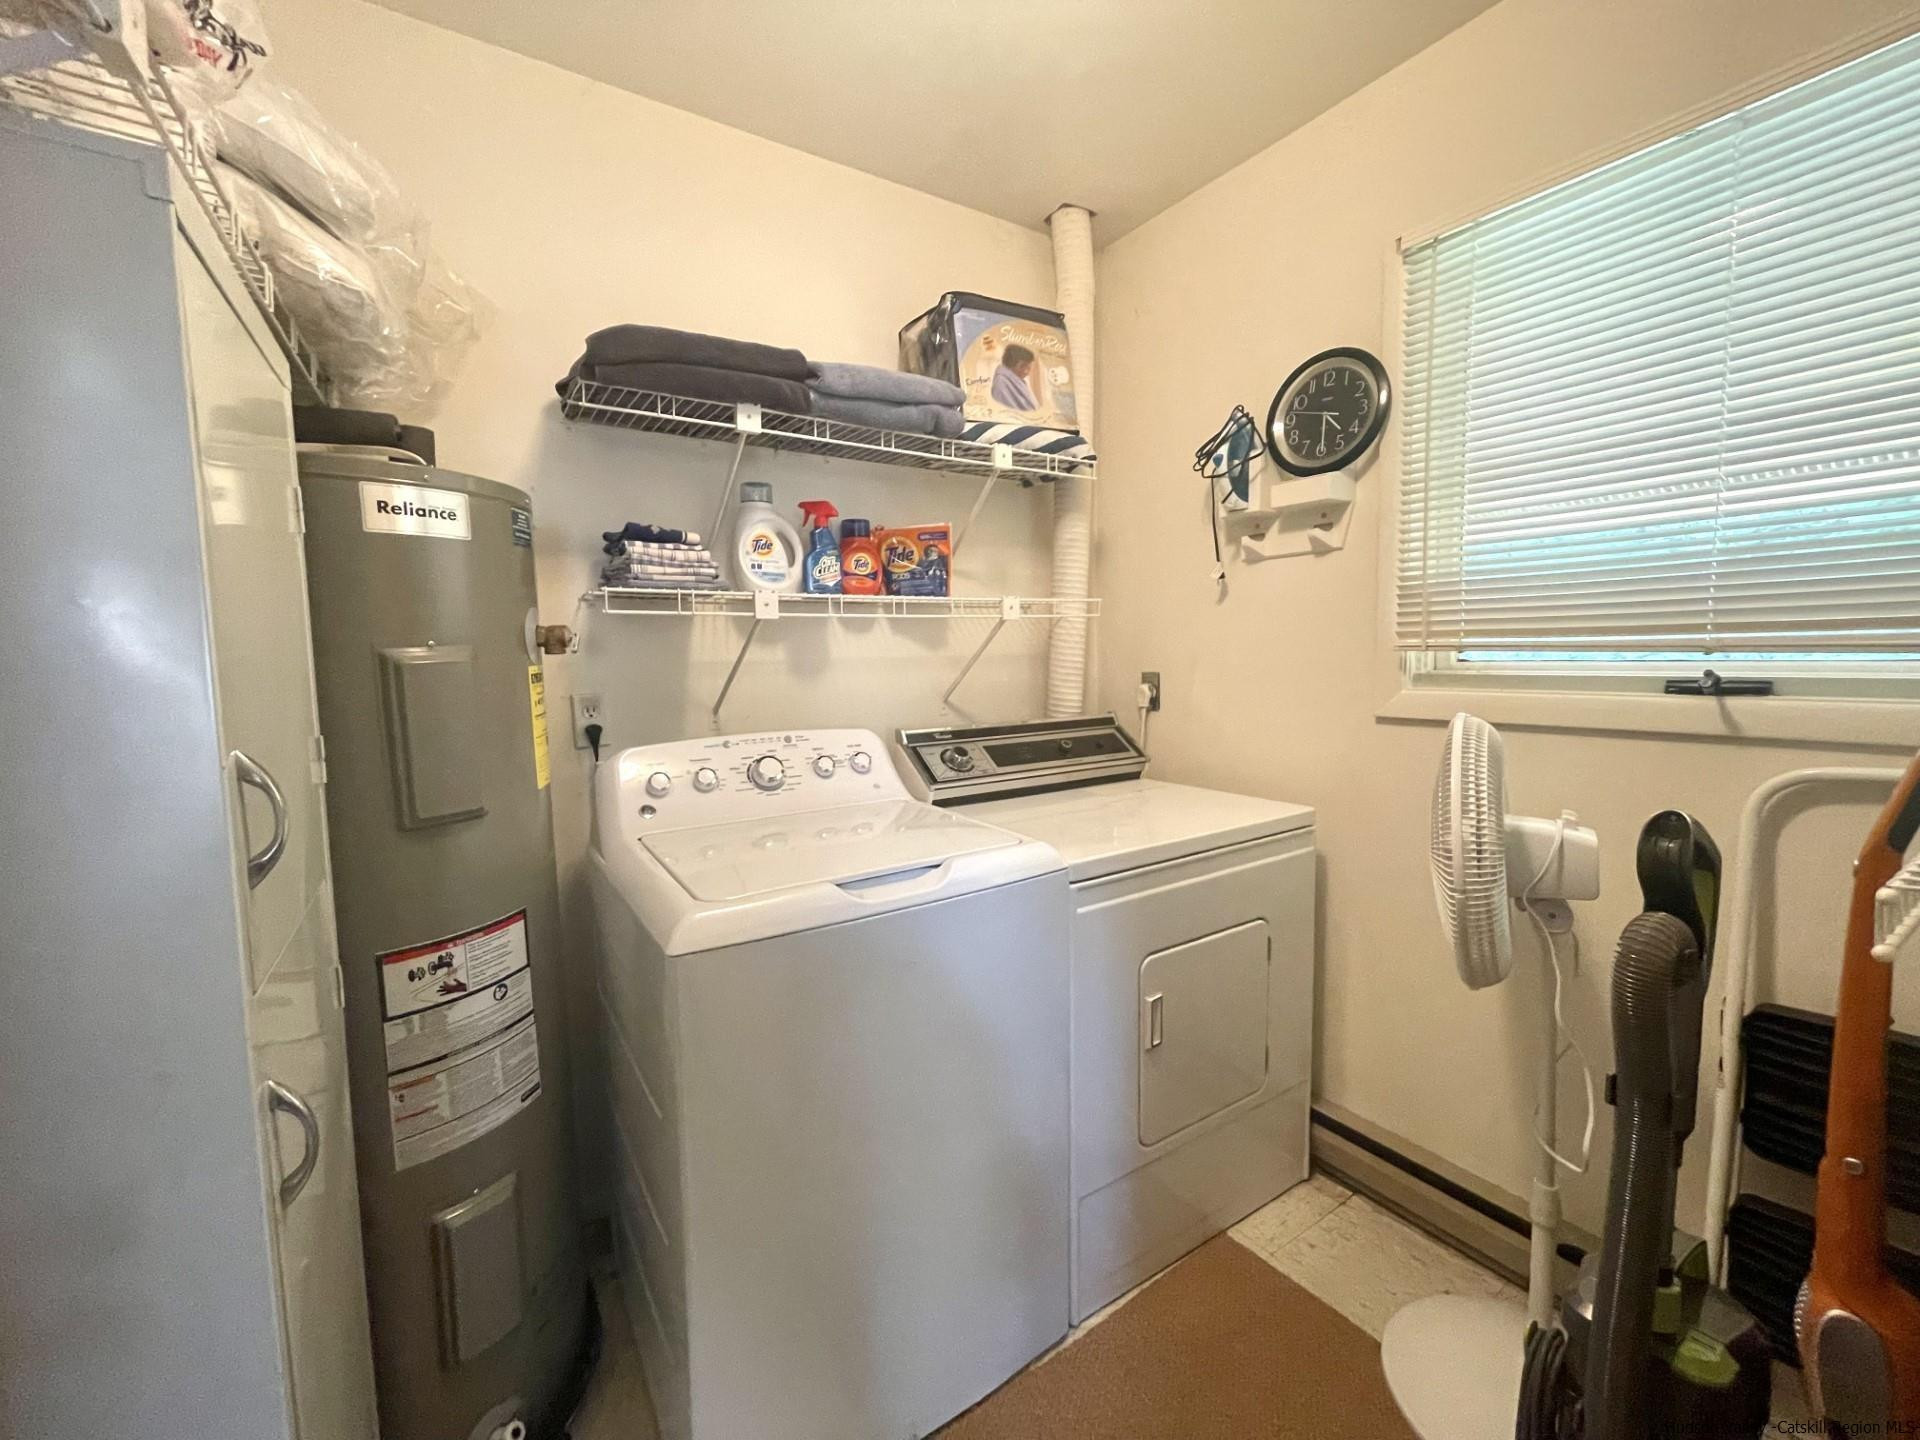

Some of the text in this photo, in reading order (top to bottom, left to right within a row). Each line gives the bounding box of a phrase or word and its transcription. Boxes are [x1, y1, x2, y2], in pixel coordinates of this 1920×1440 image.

[1323, 370, 1336, 387] 12
[1344, 370, 1349, 386] 1
[1308, 379, 1316, 394] 11
[1354, 381, 1365, 397] 2
[1293, 394, 1308, 410] 10
[1358, 398, 1368, 415] 3
[1286, 413, 1296, 428] 9
[1348, 418, 1360, 434] 4
[1289, 430, 1299, 445] 8
[1334, 434, 1345, 450] 5
[1301, 440, 1311, 455] 7
[376, 500, 458, 521] Reliance
[752, 538, 773, 553] Tide
[853, 559, 869, 570] Tide
[884, 546, 915, 567] Tide
